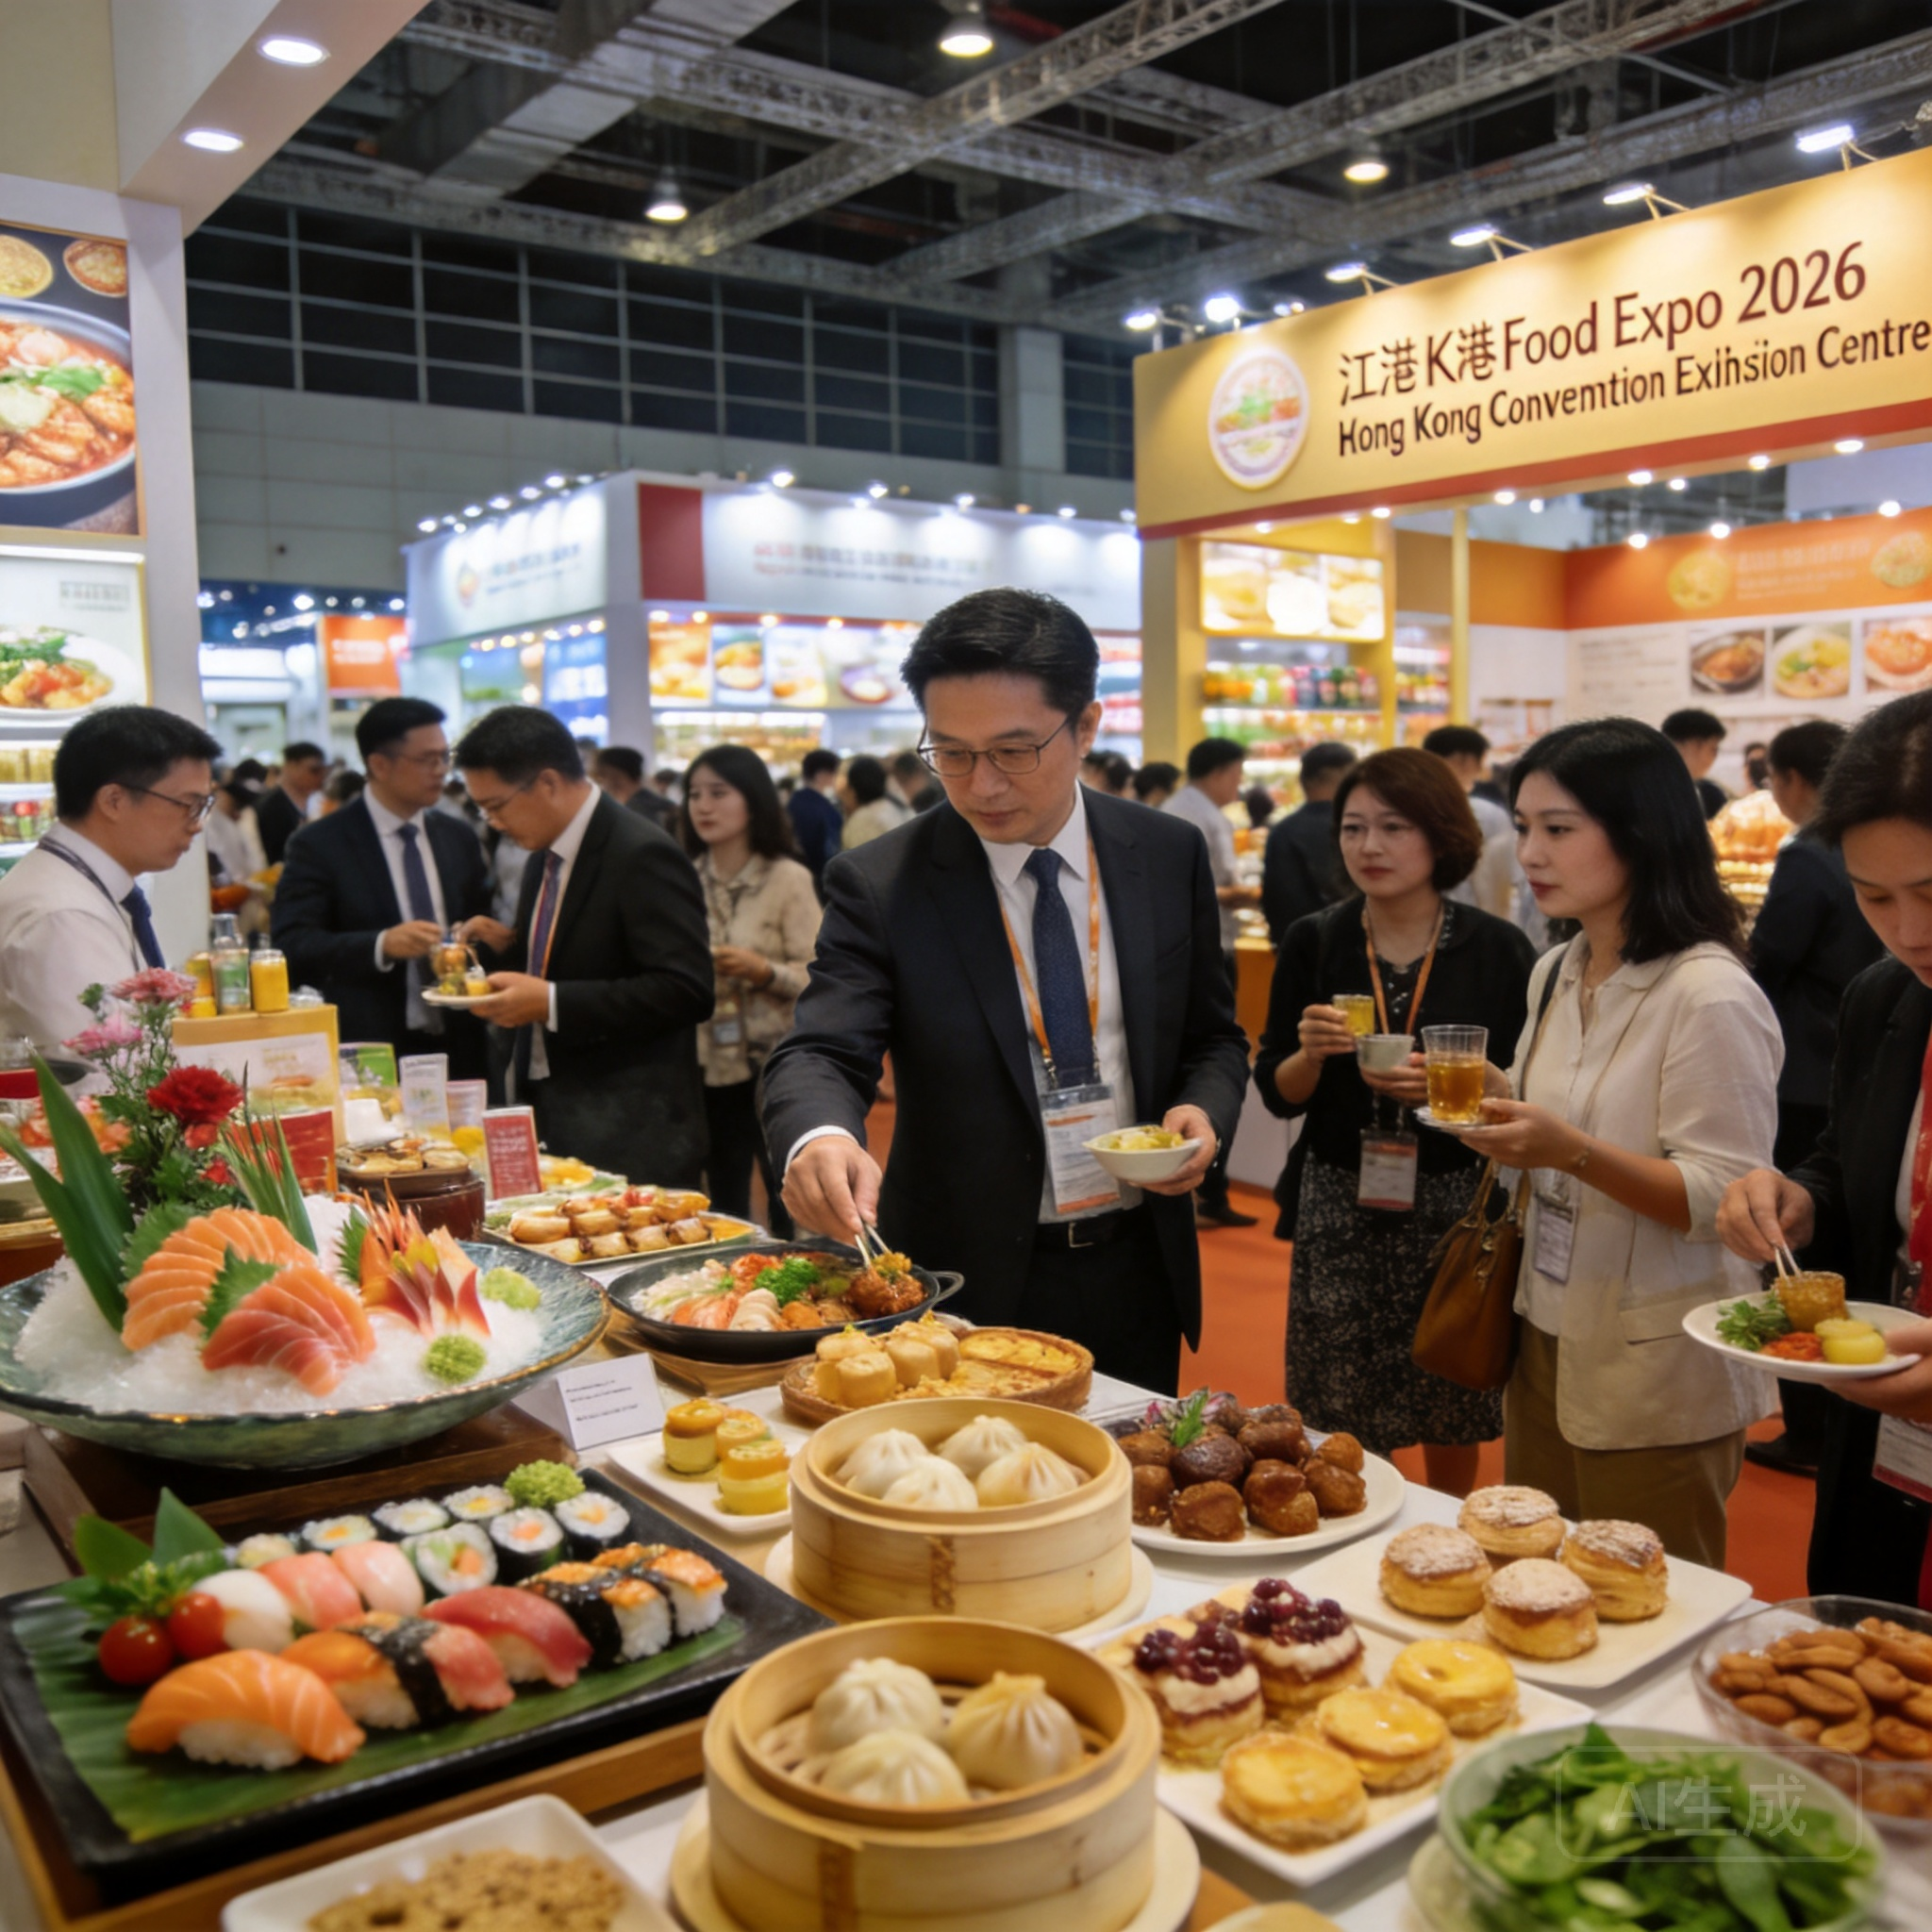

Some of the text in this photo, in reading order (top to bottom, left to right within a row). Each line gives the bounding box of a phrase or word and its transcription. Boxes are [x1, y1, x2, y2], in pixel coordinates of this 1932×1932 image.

[1504, 301, 1598, 372] Food
[1614, 291, 1723, 351] Expo
[1738, 241, 1867, 324] 2026
[1340, 418, 1405, 458] Hong
[1414, 402, 1481, 444] Kong
[1817, 319, 1931, 369] Centre
